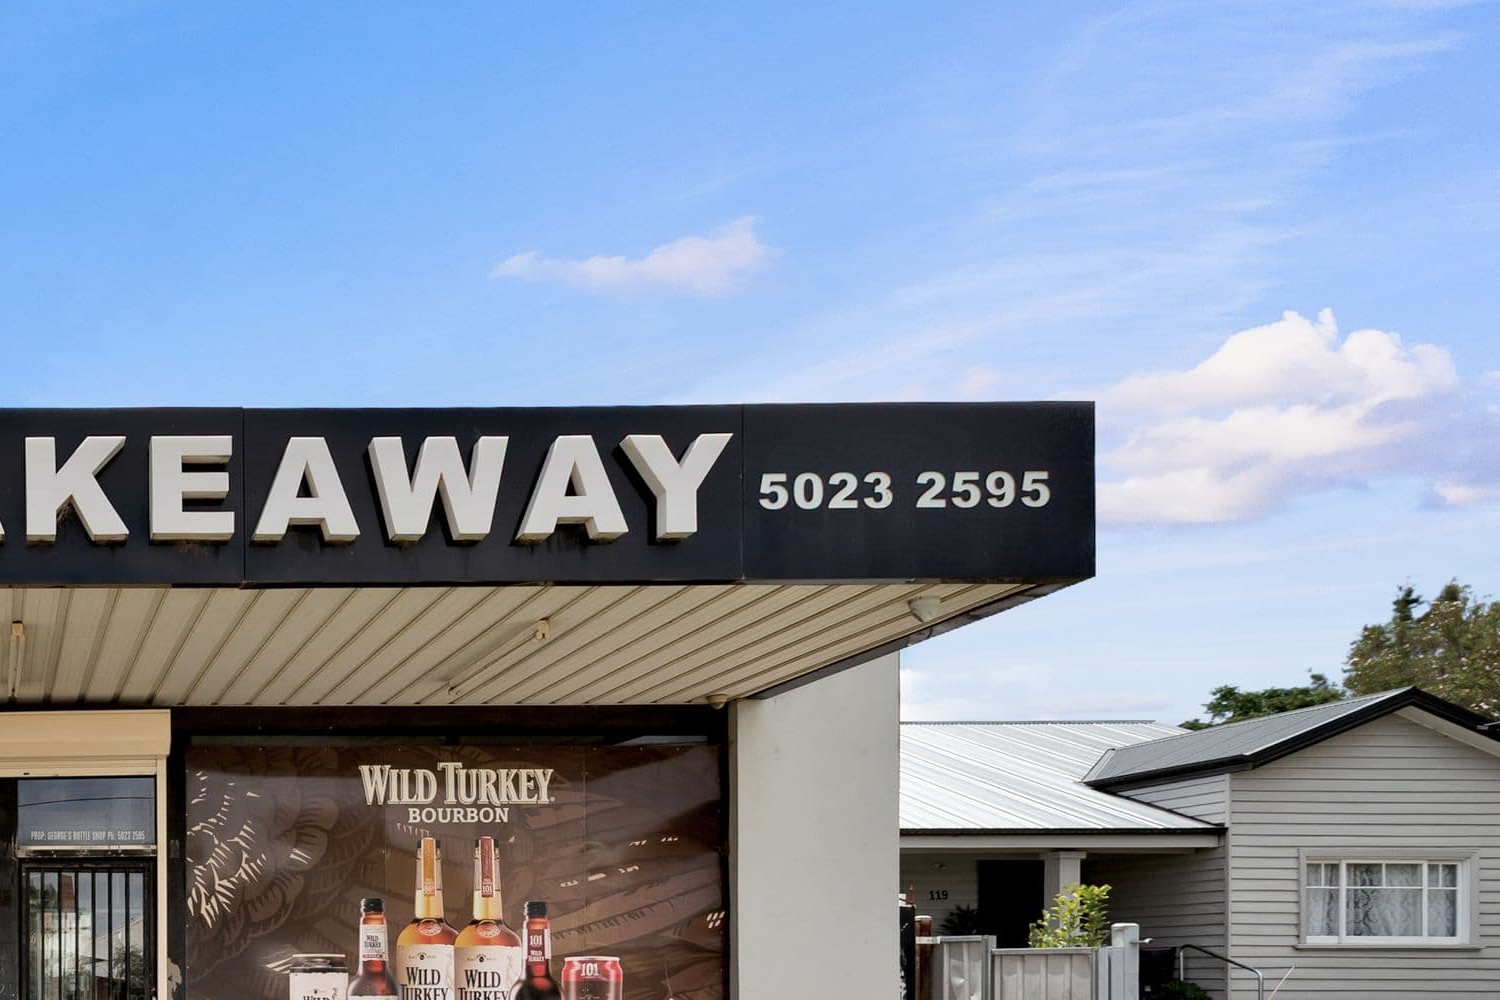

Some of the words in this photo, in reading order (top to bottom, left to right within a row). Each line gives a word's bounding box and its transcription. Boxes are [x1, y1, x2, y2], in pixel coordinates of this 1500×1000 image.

[759, 472, 894, 510] 5023
[915, 470, 1051, 509] 2595
[358, 764, 438, 806] WILD
[408, 807, 510, 824] BOURBON
[929, 890, 949, 900] 119
[529, 935, 543, 945] 101
[406, 967, 441, 985] WILD
[581, 963, 599, 976] 101
[464, 969, 501, 988] WILD
